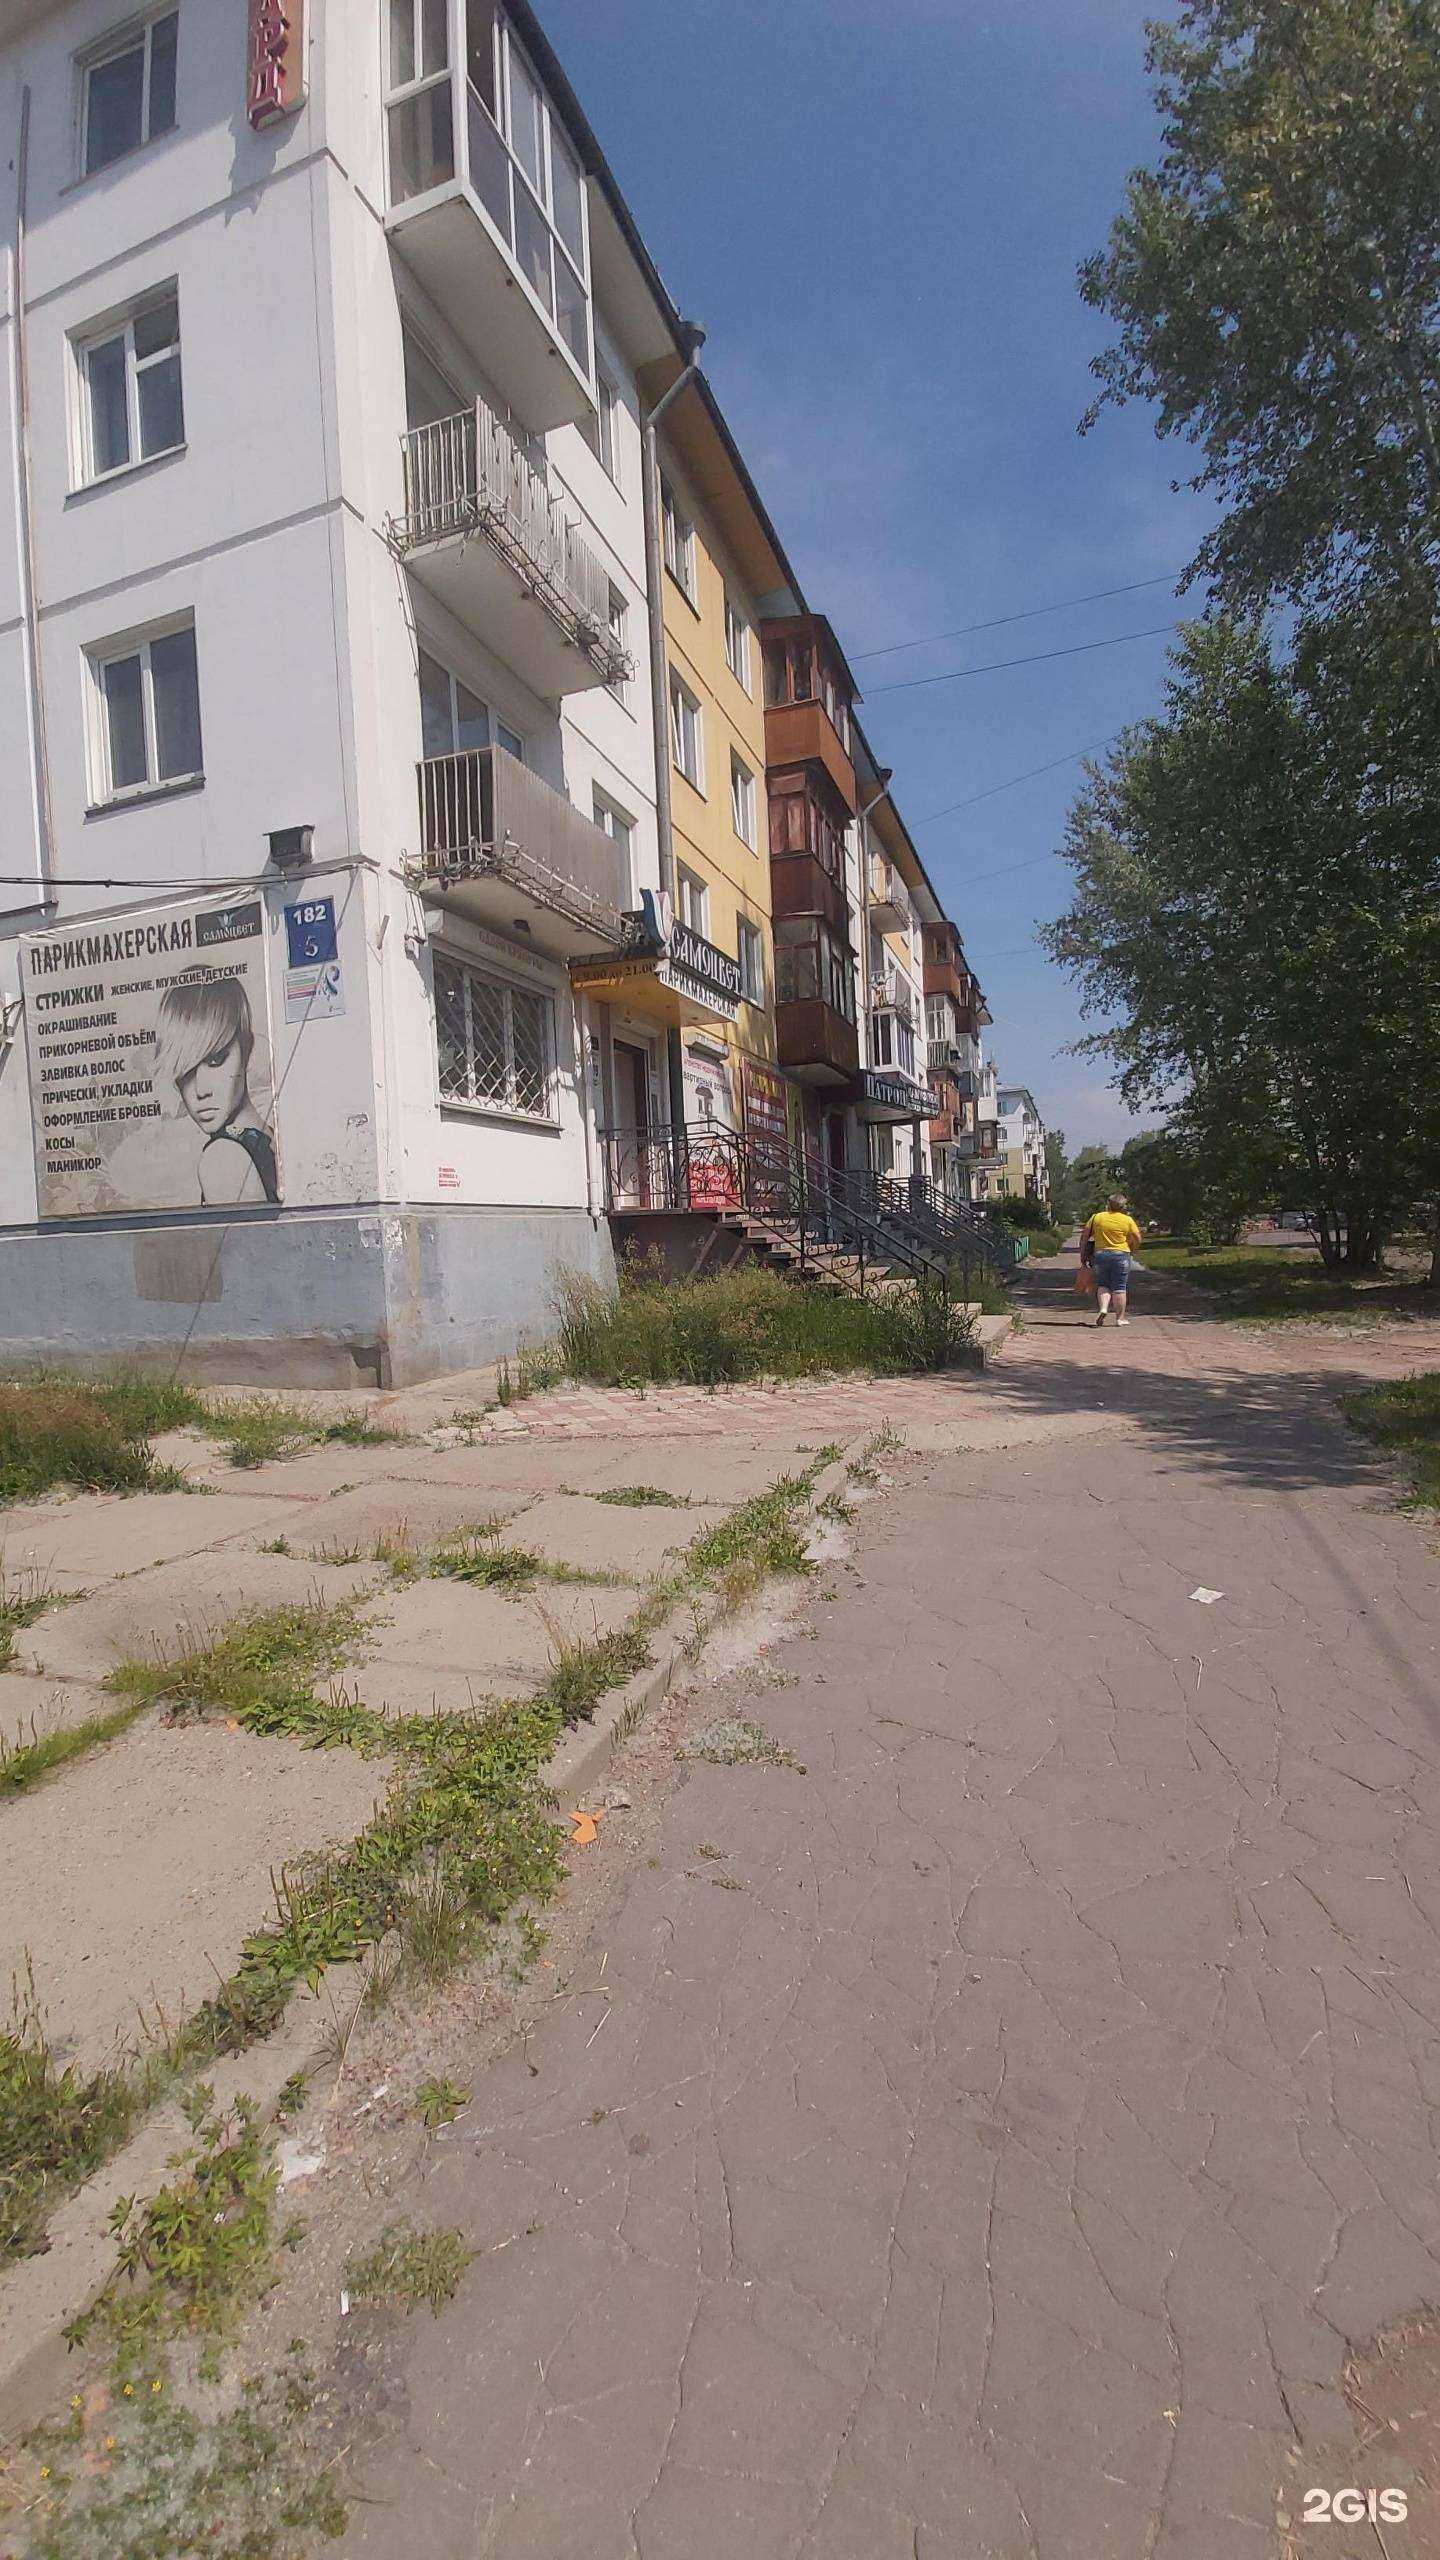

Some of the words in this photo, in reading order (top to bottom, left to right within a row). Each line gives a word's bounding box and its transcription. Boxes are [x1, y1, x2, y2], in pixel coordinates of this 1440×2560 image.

[293, 904, 327, 926] 182
[31, 918, 192, 975] ПАРИКМАХЕРСКАЯ
[36, 983, 104, 1011] СТРИЖКИ
[111, 980, 154, 997] ЖЕНСКИЕ,
[156, 971, 205, 988] МУЖСКИЕ,
[205, 963, 248, 983] ДЕТСКИЕ
[38, 1012, 118, 1036] ОКРАШИВАНИЕ
[39, 1034, 116, 1059] ПРИКОРНЕВОЙ
[118, 1029, 157, 1049] ОБЪЁМ
[41, 1065, 88, 1082] ЗАВИВКА
[90, 1059, 126, 1076] ВОЛОС
[42, 1087, 99, 1105] ПРИЧЕСКИ,
[101, 1080, 153, 1099] УКЛАДКИ
[44, 1108, 117, 1128] ОФОРМЛЕНИЕ
[118, 1100, 162, 1121] БРОВЕЙ
[45, 1136, 75, 1151] КОСЫ
[47, 1157, 102, 1174] МАНИКЮР
